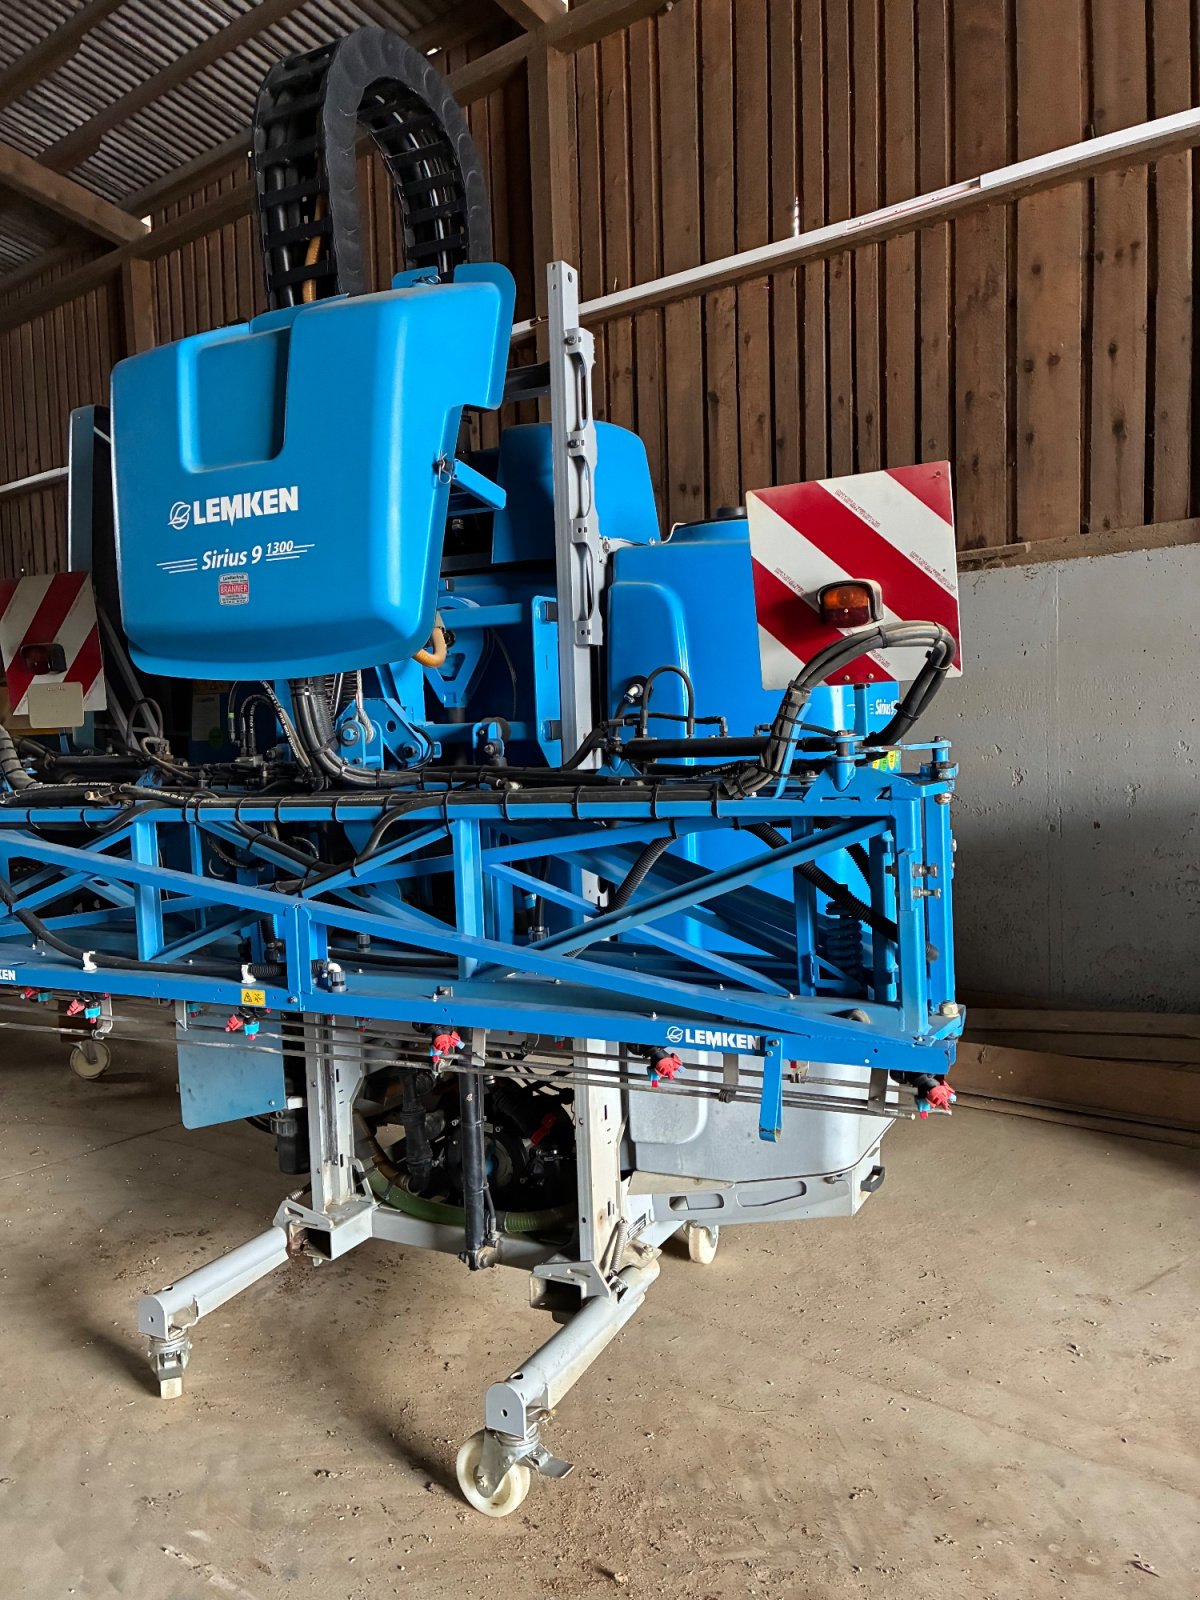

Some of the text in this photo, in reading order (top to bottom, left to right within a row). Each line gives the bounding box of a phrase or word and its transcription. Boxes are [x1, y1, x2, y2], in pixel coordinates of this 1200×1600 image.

[193, 486, 299, 526] LEMKEN
[201, 540, 294, 570] Sirius 9 1300
[220, 584, 248, 594] BRANNER
[685, 1029, 760, 1050] LEMKEN
